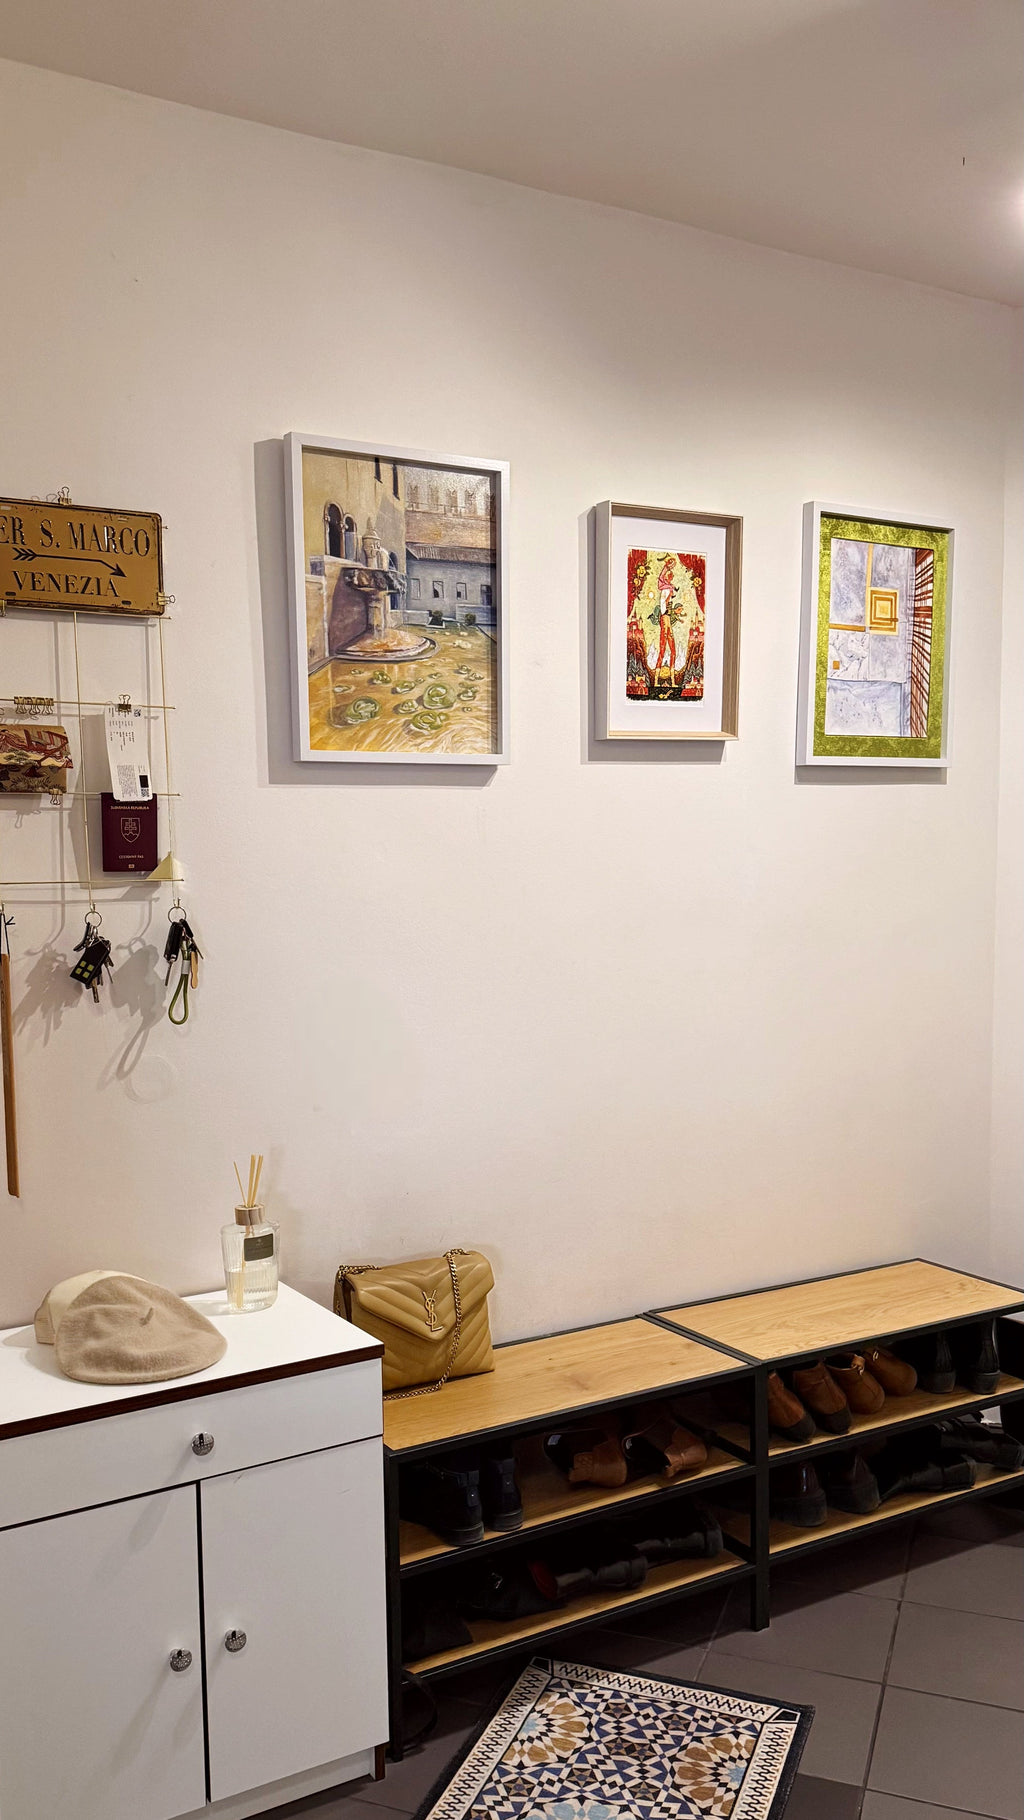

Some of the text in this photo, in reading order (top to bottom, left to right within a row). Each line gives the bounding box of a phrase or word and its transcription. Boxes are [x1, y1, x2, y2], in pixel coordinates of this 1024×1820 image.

[40, 518, 60, 549] S.
[66, 521, 150, 557] MARCO
[12, 570, 121, 598] VENEZIA
